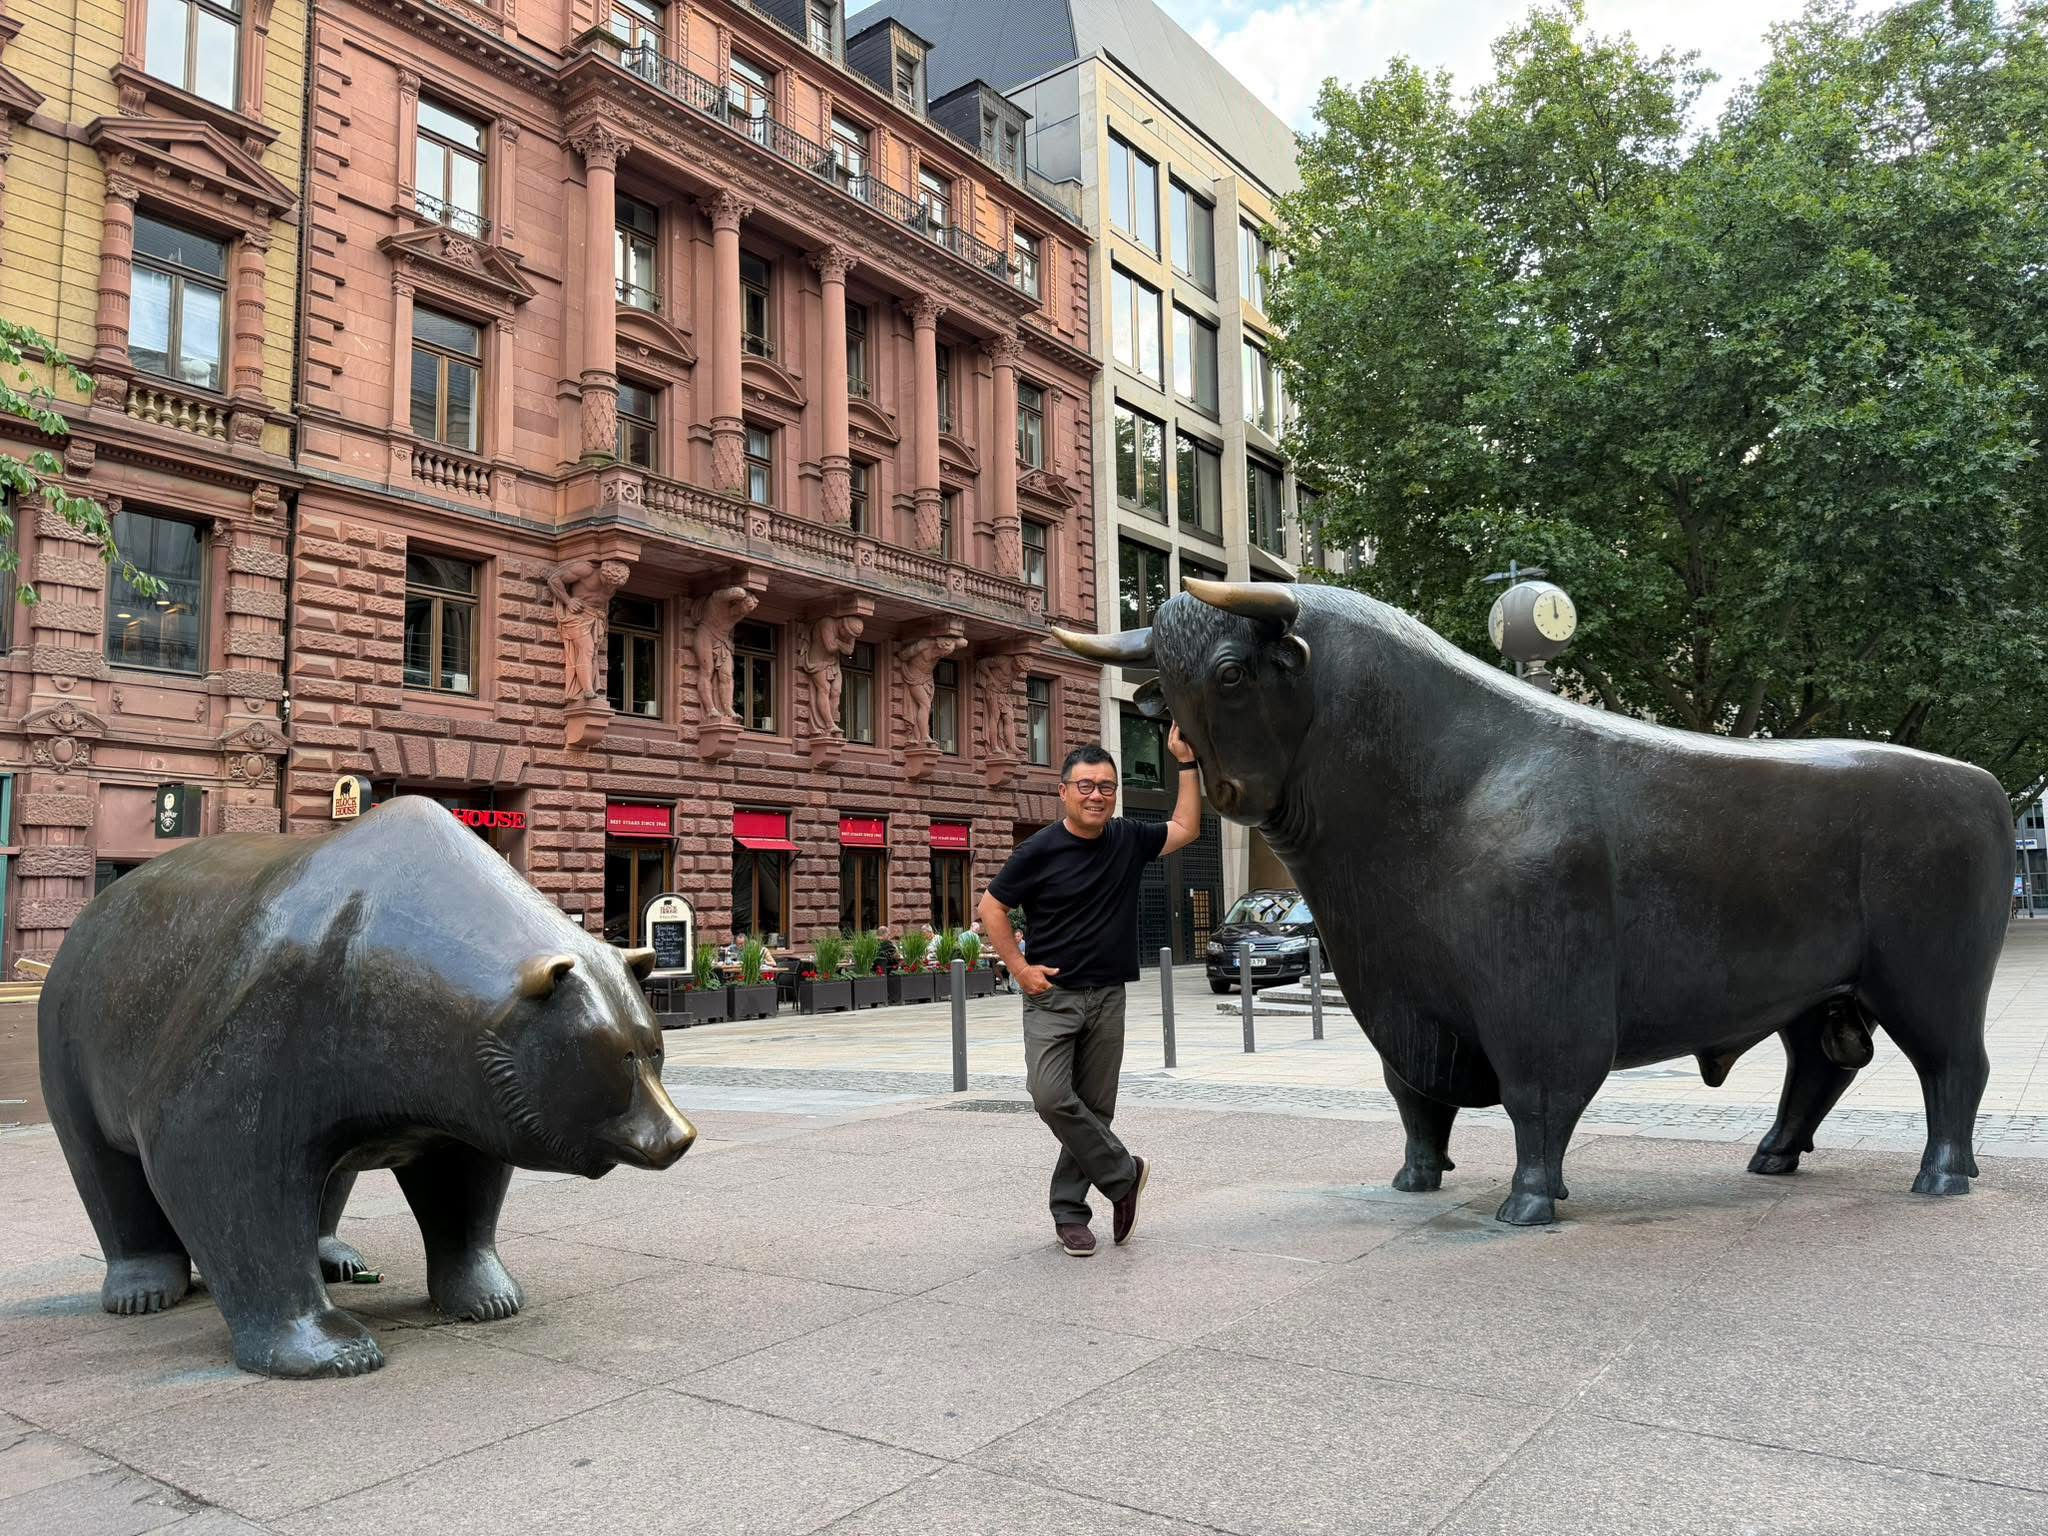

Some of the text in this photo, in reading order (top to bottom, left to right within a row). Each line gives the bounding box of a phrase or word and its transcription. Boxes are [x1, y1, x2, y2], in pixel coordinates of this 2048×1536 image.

[336, 797, 357, 807] BLOCK
[336, 806, 357, 816] HOUSE
[452, 808, 527, 829] HOUSE
